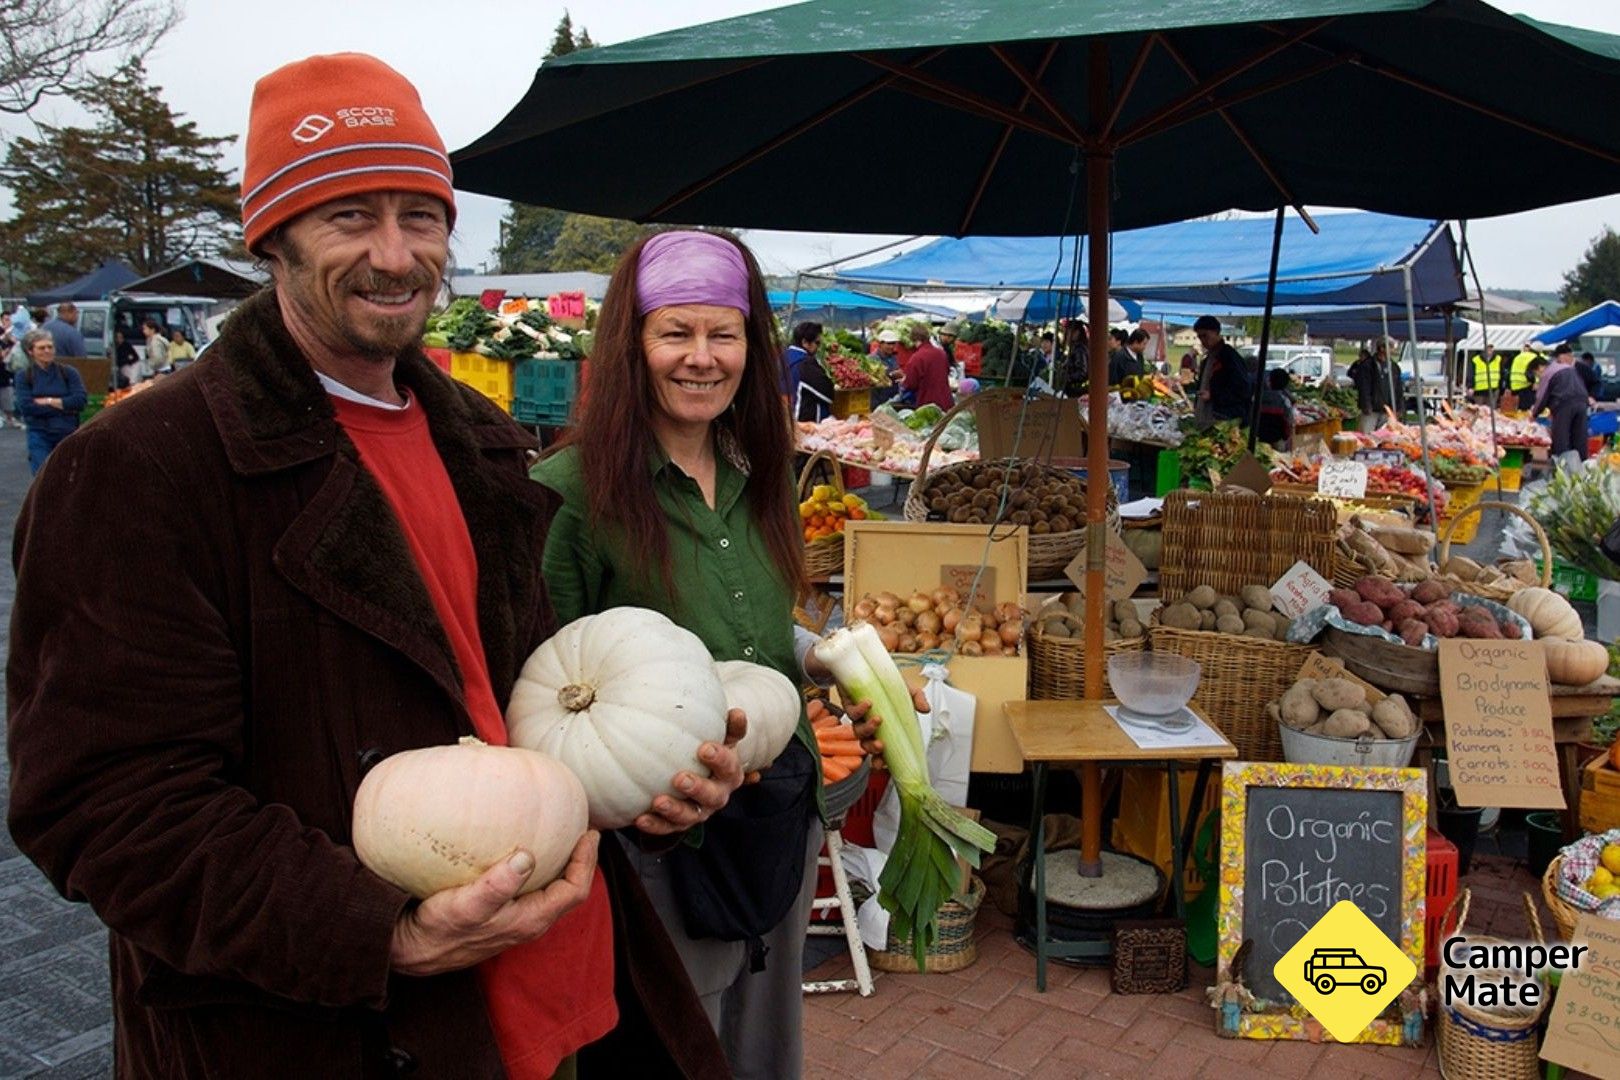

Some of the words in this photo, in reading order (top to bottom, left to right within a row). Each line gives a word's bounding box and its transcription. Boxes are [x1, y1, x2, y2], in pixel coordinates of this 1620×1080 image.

[336, 106, 395, 119] SCOTT
[345, 116, 396, 128] BASE
[1459, 641, 1528, 666] Organic
[1456, 672, 1541, 699] Biodynamic
[1474, 695, 1527, 716] Produce
[1266, 804, 1393, 863] Organic
[1261, 859, 1390, 918] Potatoes
